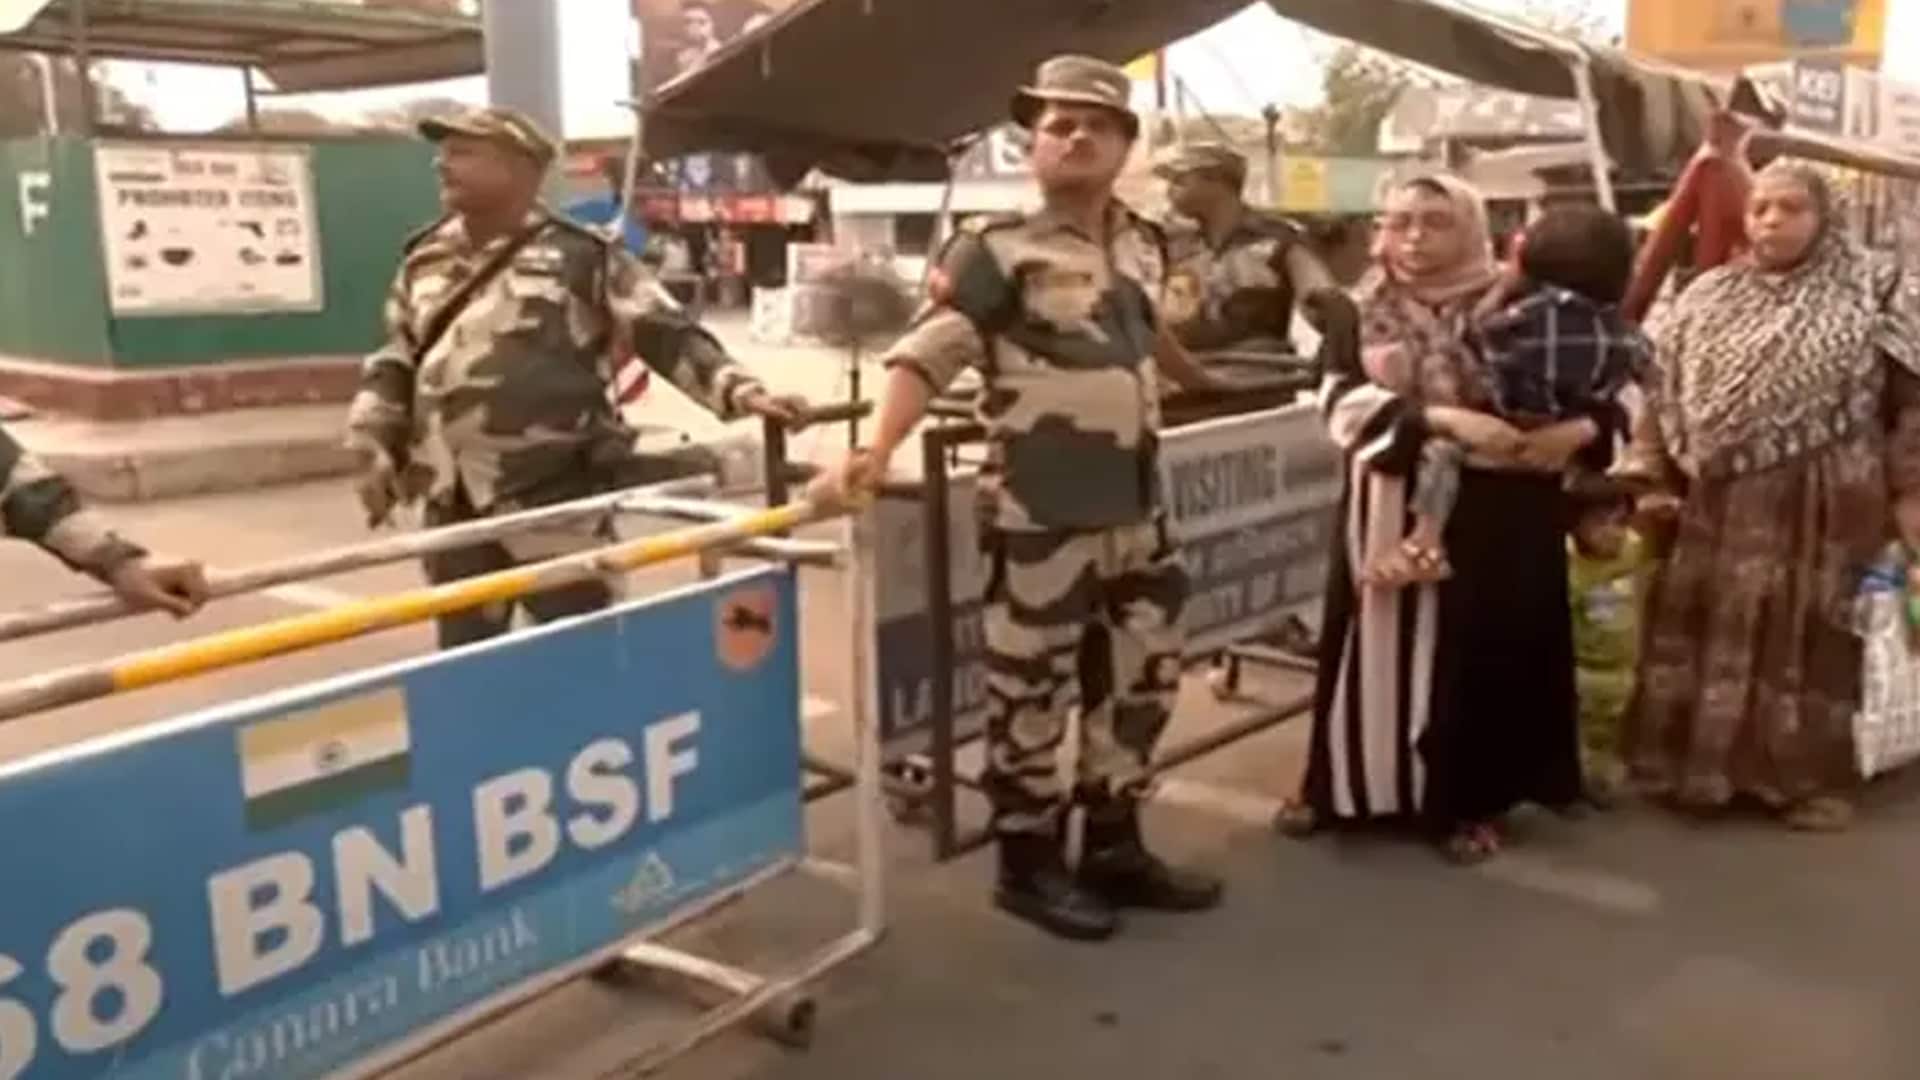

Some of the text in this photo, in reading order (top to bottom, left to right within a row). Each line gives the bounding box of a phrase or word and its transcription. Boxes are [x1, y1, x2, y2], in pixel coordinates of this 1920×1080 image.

[206, 803, 441, 997] BN
[472, 708, 703, 893] BSF
[415, 906, 538, 993] Bank
